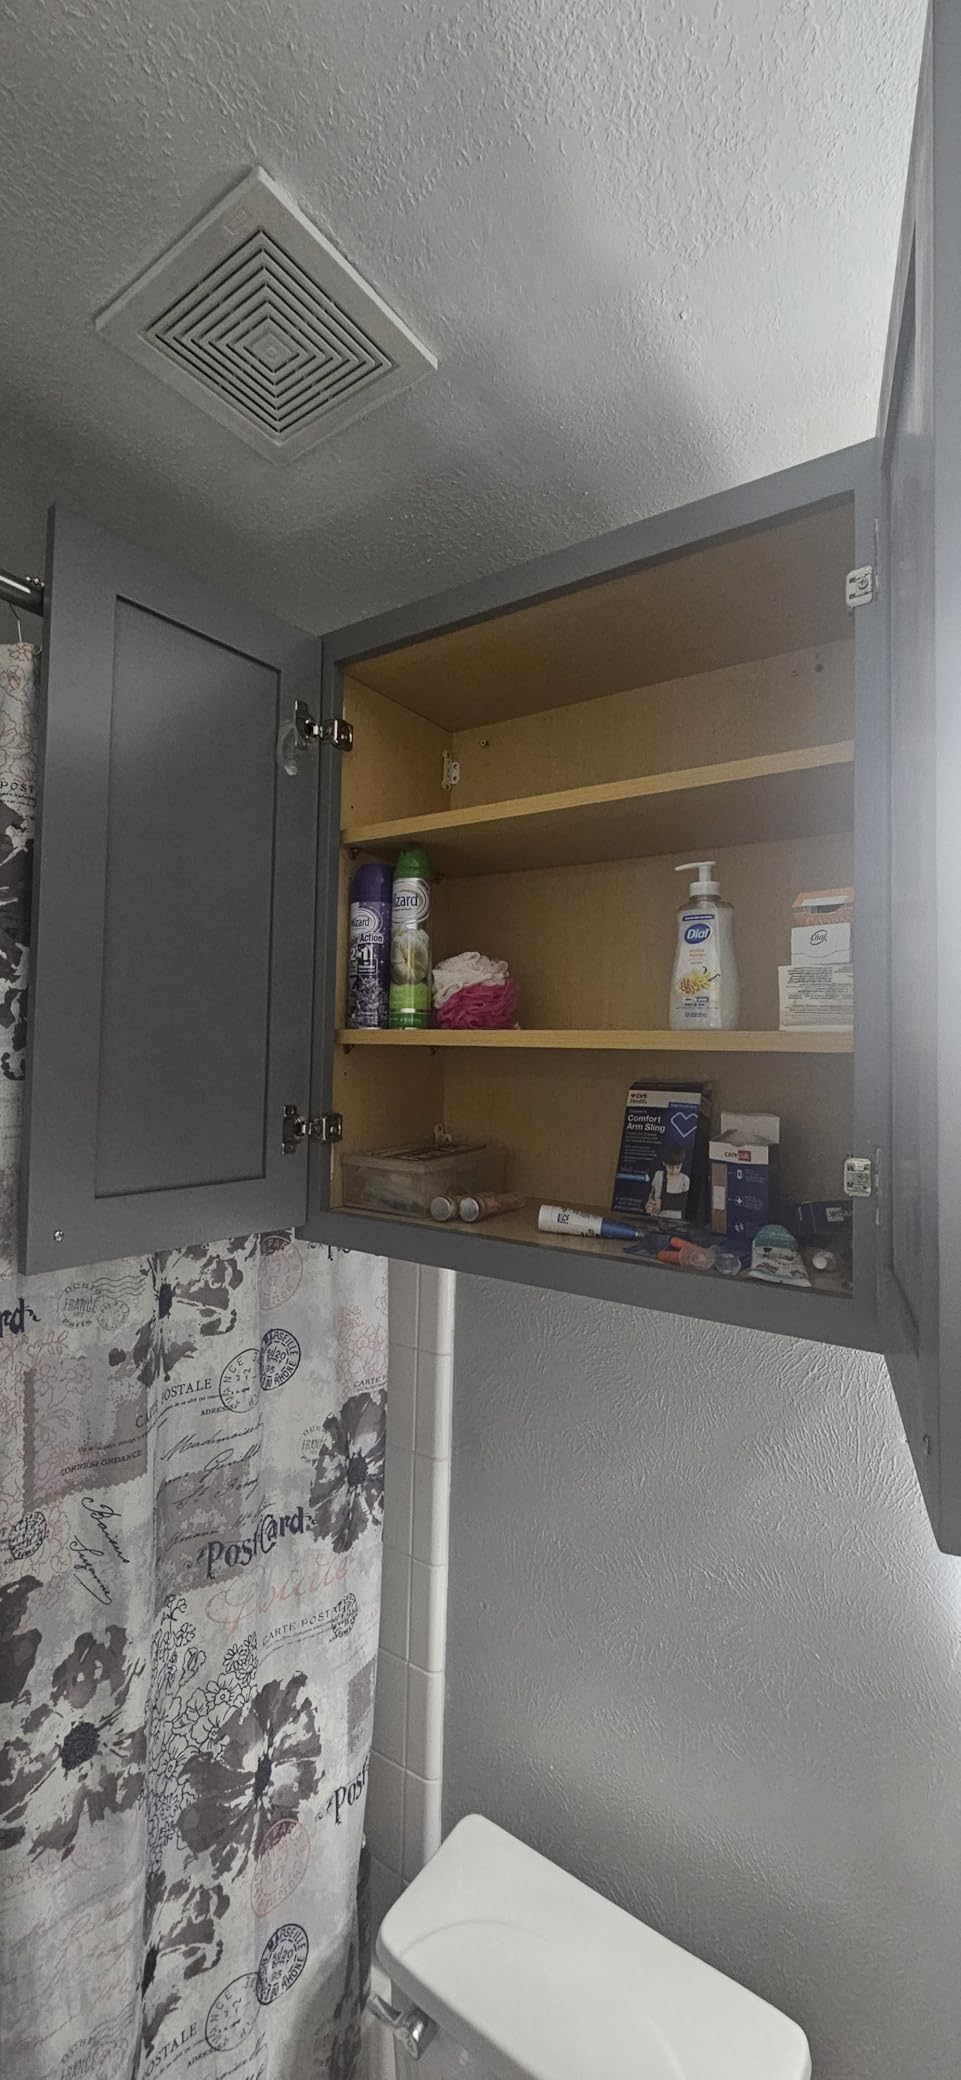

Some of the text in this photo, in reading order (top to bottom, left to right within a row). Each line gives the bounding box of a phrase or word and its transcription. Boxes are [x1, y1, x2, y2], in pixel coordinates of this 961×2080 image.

[394, 893, 418, 908] izard
[360, 933, 384, 944] Action
[687, 928, 710, 940] Dial
[627, 1114, 662, 1123] Comfort
[626, 1123, 666, 1134] Arm Sling
[144, 2022, 198, 2078] OSTALE
